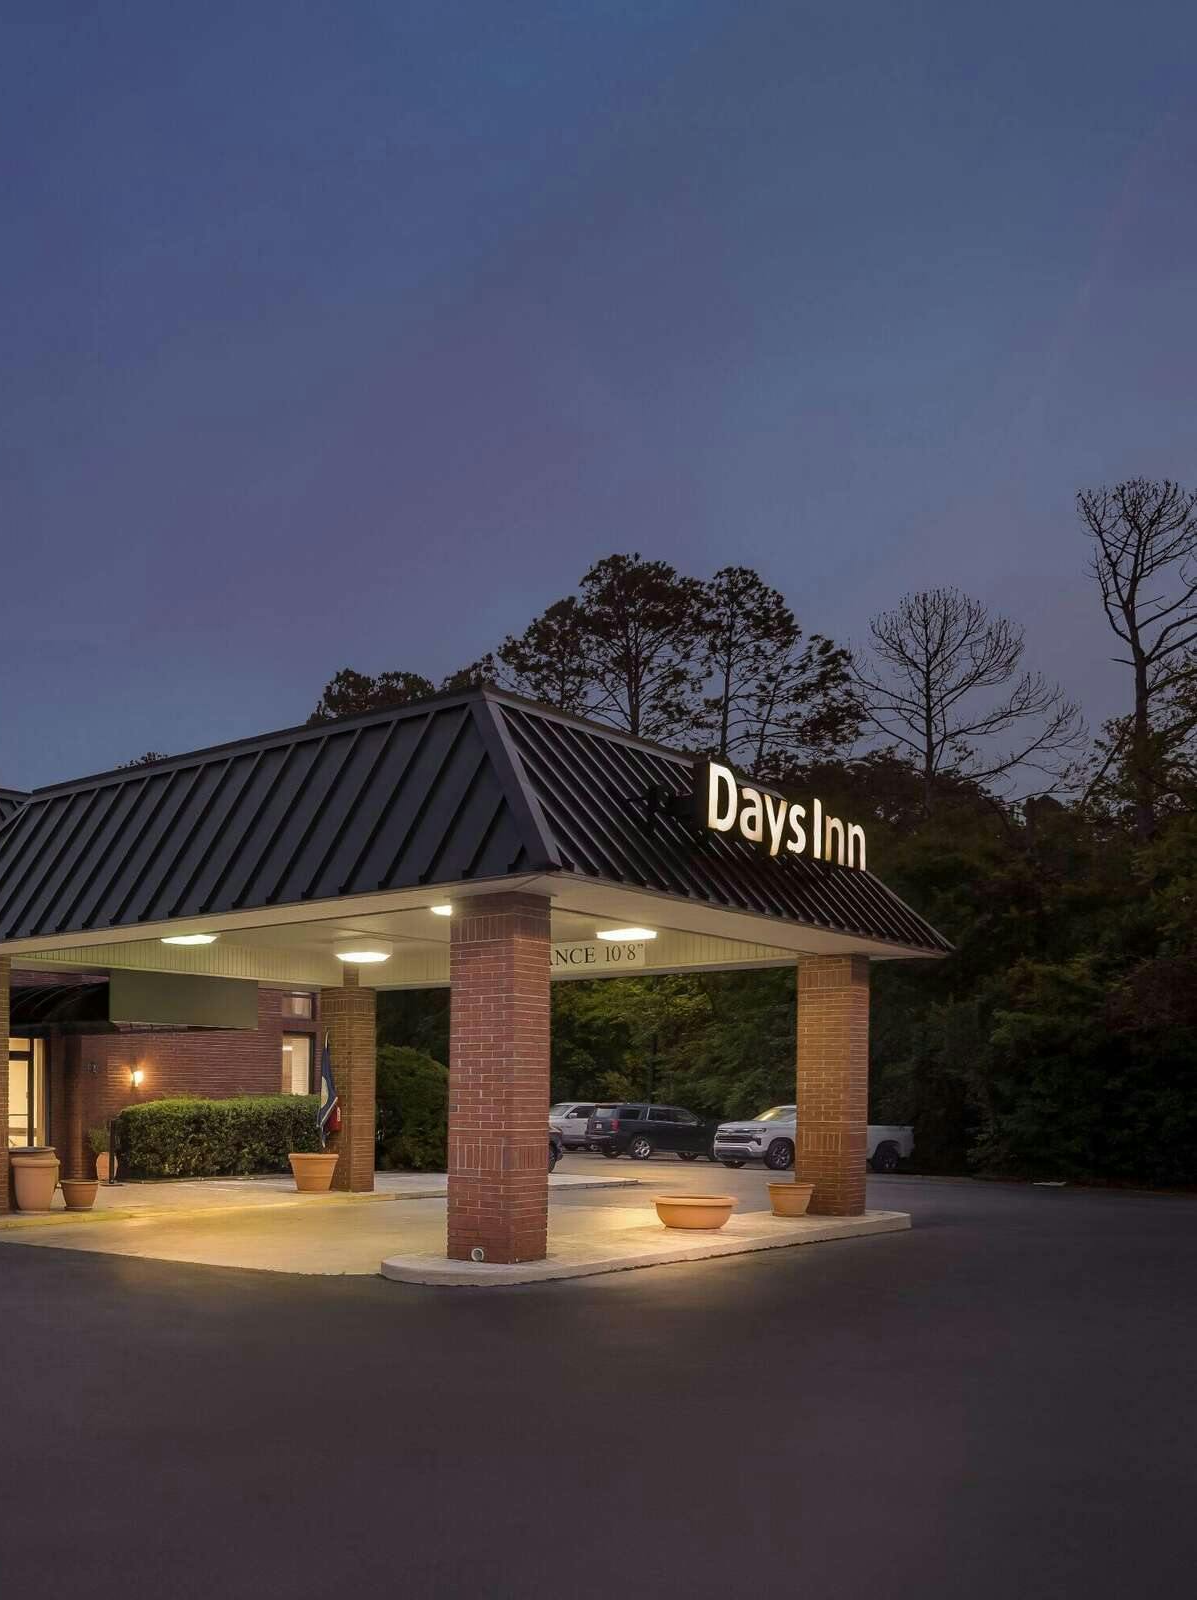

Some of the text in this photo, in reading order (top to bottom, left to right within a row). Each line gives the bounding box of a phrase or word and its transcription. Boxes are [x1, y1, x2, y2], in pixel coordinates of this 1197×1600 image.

[707, 761, 867, 872] Days Inn
[550, 947, 596, 966] NCE
